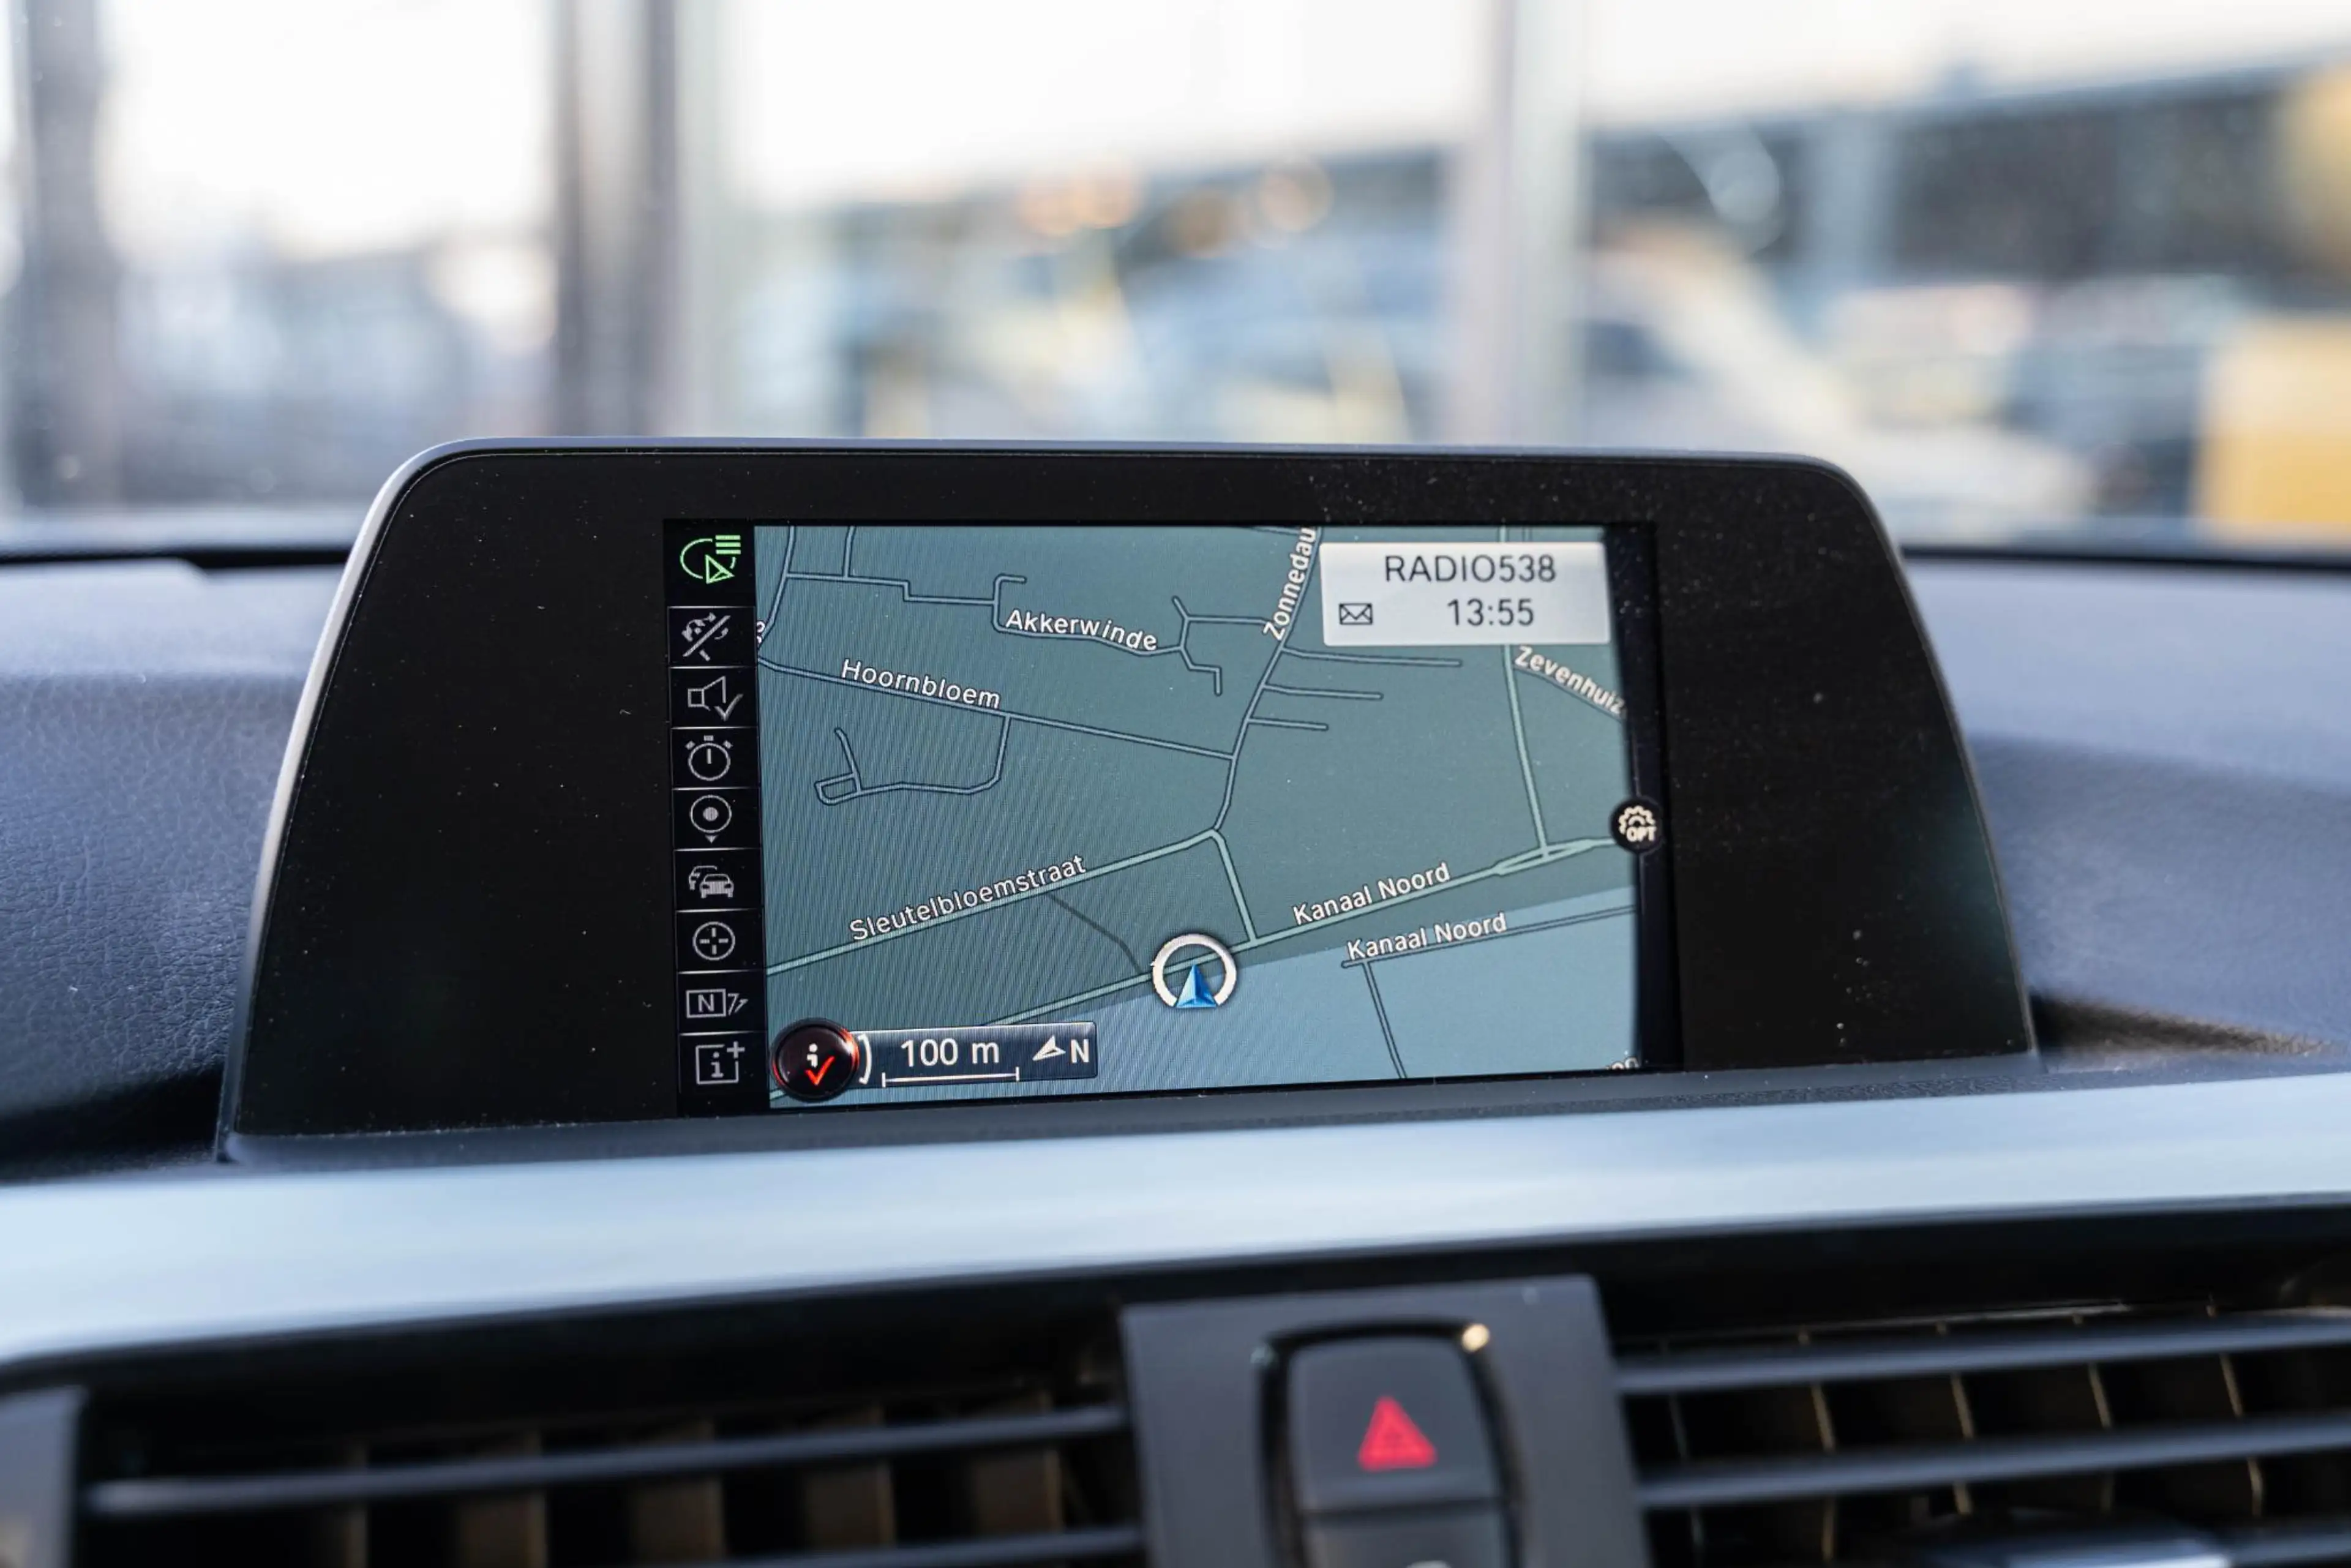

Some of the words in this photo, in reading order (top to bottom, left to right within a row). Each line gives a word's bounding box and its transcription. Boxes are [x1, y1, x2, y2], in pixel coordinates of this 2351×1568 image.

[1384, 555, 1556, 582] RADIO538
[1005, 609, 1158, 651] Akkerwinde
[1447, 598, 1534, 626] 13:55
[841, 658, 1000, 709] Hoornbloem
[849, 855, 1087, 940] Sleutelbloemstraat
[1293, 886, 1372, 926] Kanaal
[1378, 862, 1451, 901] Noord
[1347, 927, 1427, 961] Kanaal
[1434, 913, 1507, 943] Noord
[901, 1038, 958, 1067] 100
[972, 1041, 1000, 1064] m
[1070, 1038, 1089, 1063] N
